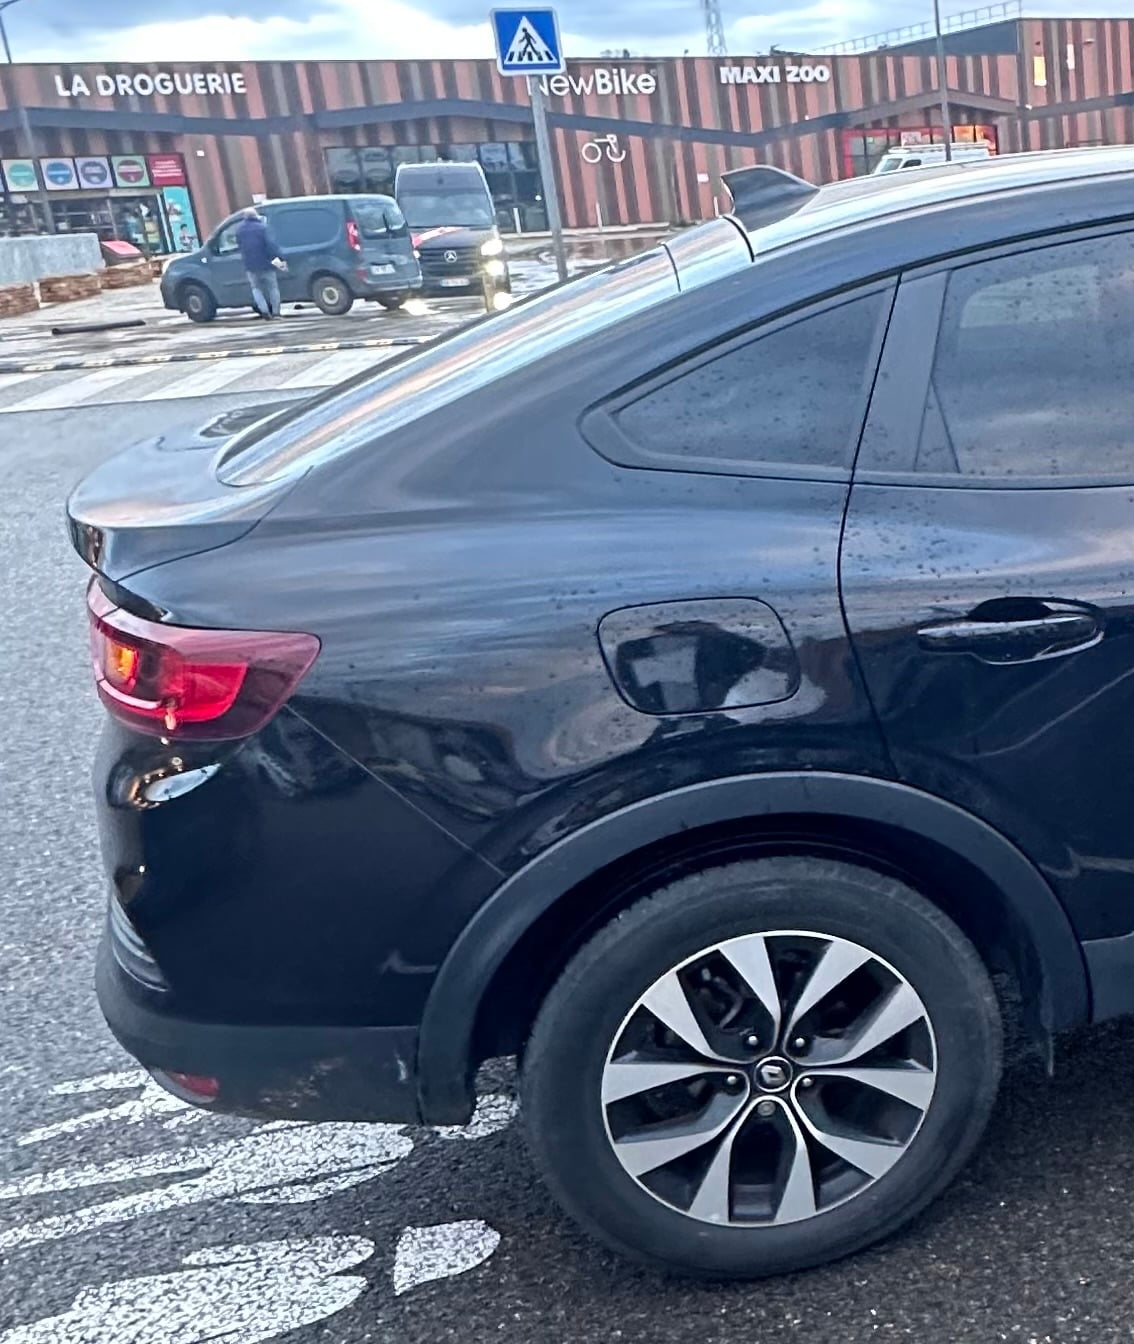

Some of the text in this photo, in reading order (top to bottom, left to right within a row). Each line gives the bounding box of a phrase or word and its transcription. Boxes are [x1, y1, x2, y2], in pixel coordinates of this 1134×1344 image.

[54, 72, 247, 97] LA DROGUERIE
[719, 64, 830, 84] MAXI ZOO
